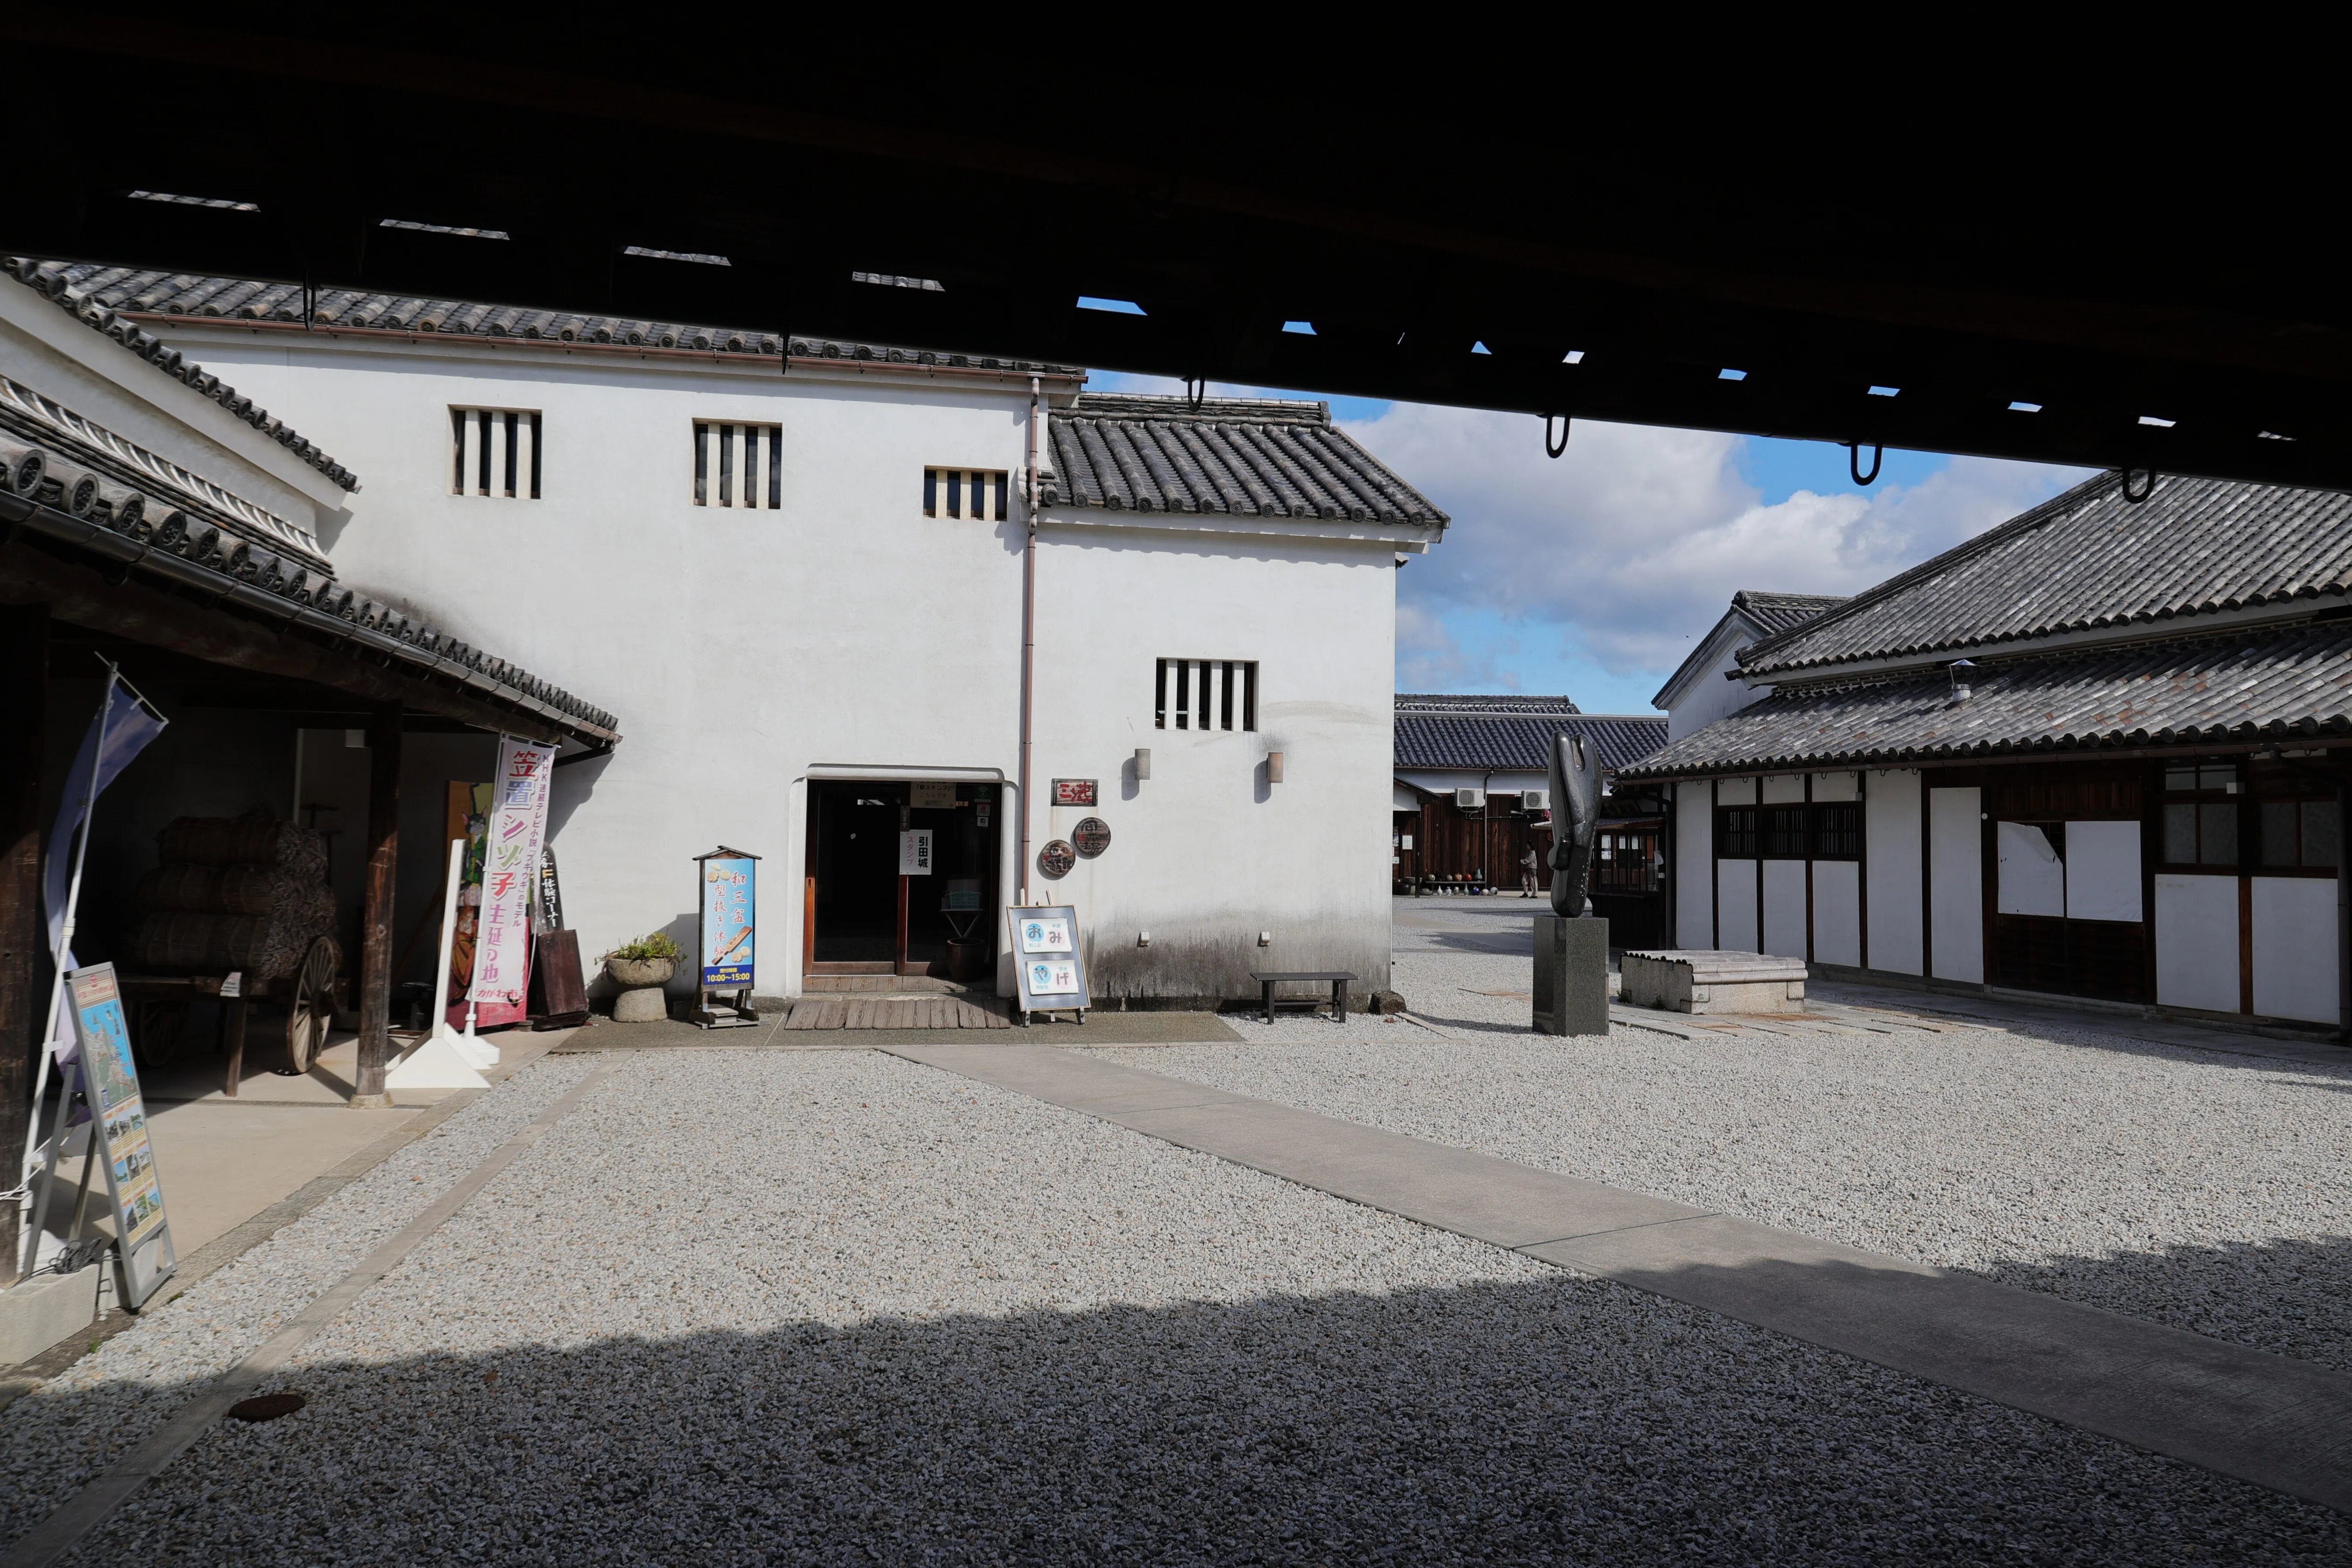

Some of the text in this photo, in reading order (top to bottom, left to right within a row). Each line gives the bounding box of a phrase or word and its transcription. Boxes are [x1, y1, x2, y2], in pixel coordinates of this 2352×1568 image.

[918, 836, 928, 868] 引田城
[541, 878, 559, 927] 体験コーナー
[714, 884, 727, 958] 型抜き体験
[730, 872, 746, 924] 和三盆
